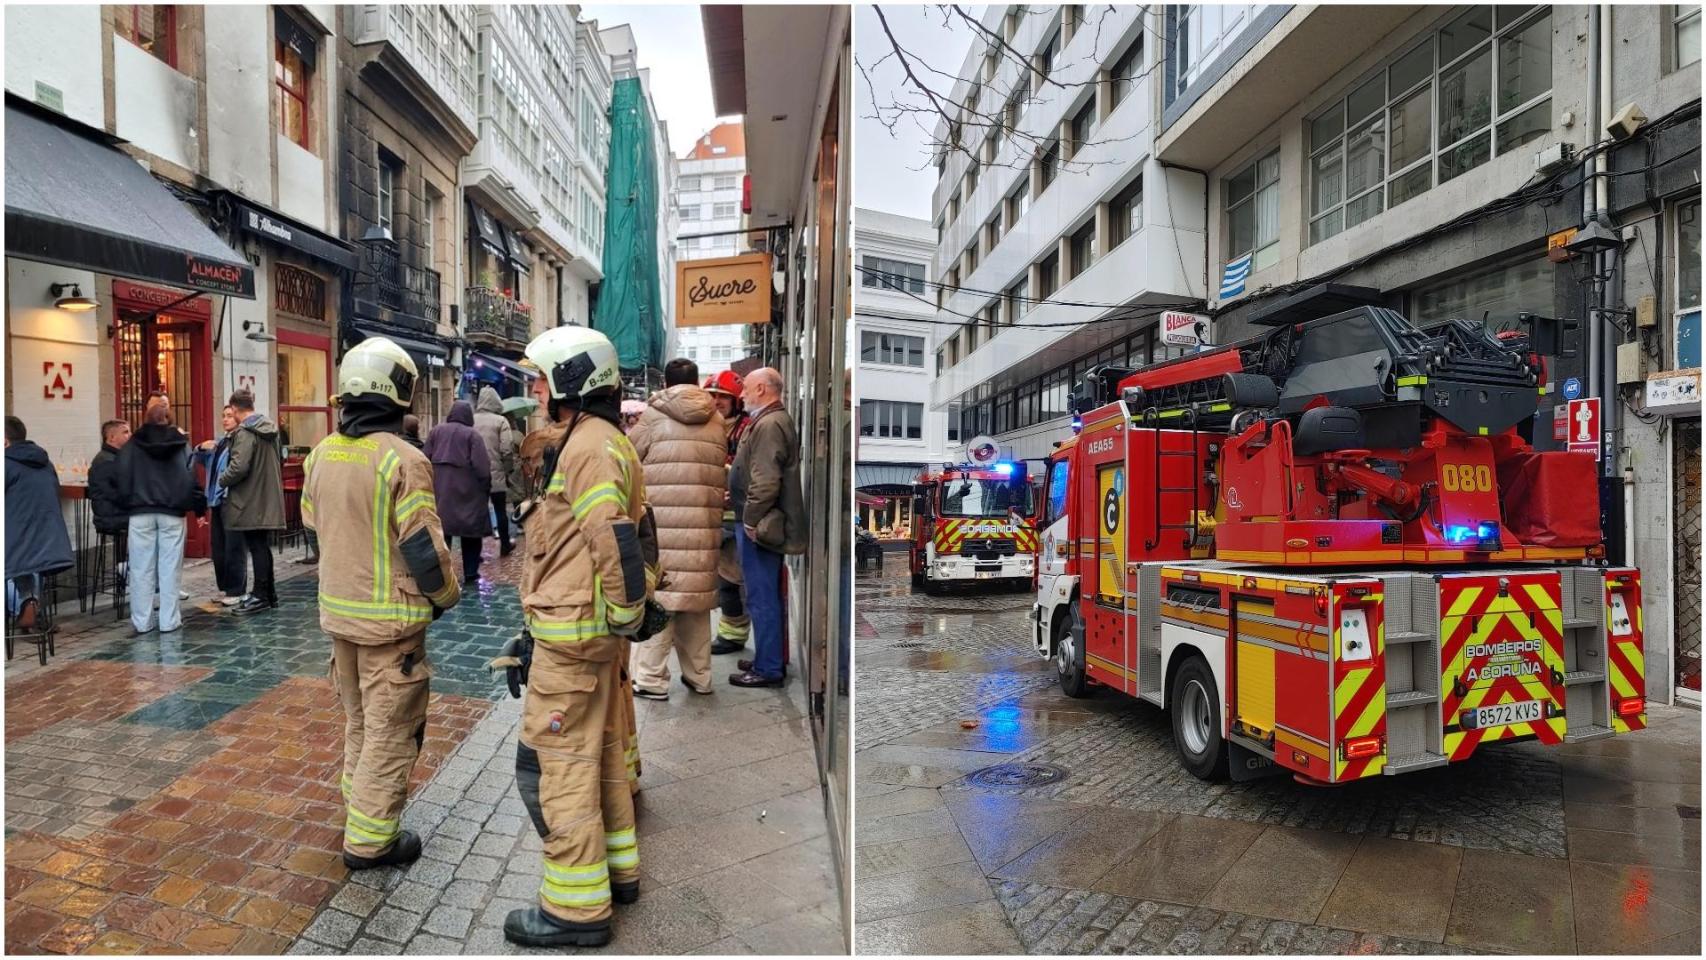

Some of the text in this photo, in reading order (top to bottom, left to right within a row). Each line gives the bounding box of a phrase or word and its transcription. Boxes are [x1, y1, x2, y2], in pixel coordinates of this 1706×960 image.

[195, 278, 220, 289] CONCEPT
[689, 276, 757, 308] Sucre
[1166, 314, 1197, 331] BLANCA
[370, 381, 392, 393] B-117
[588, 367, 613, 388] B-293
[1087, 437, 1114, 455] AEA55
[1442, 463, 1492, 492] 080
[1466, 639, 1541, 658] BOMBEIROS
[1466, 659, 1542, 682] A CORUÑA
[1480, 702, 1539, 725] 8572 KVS
